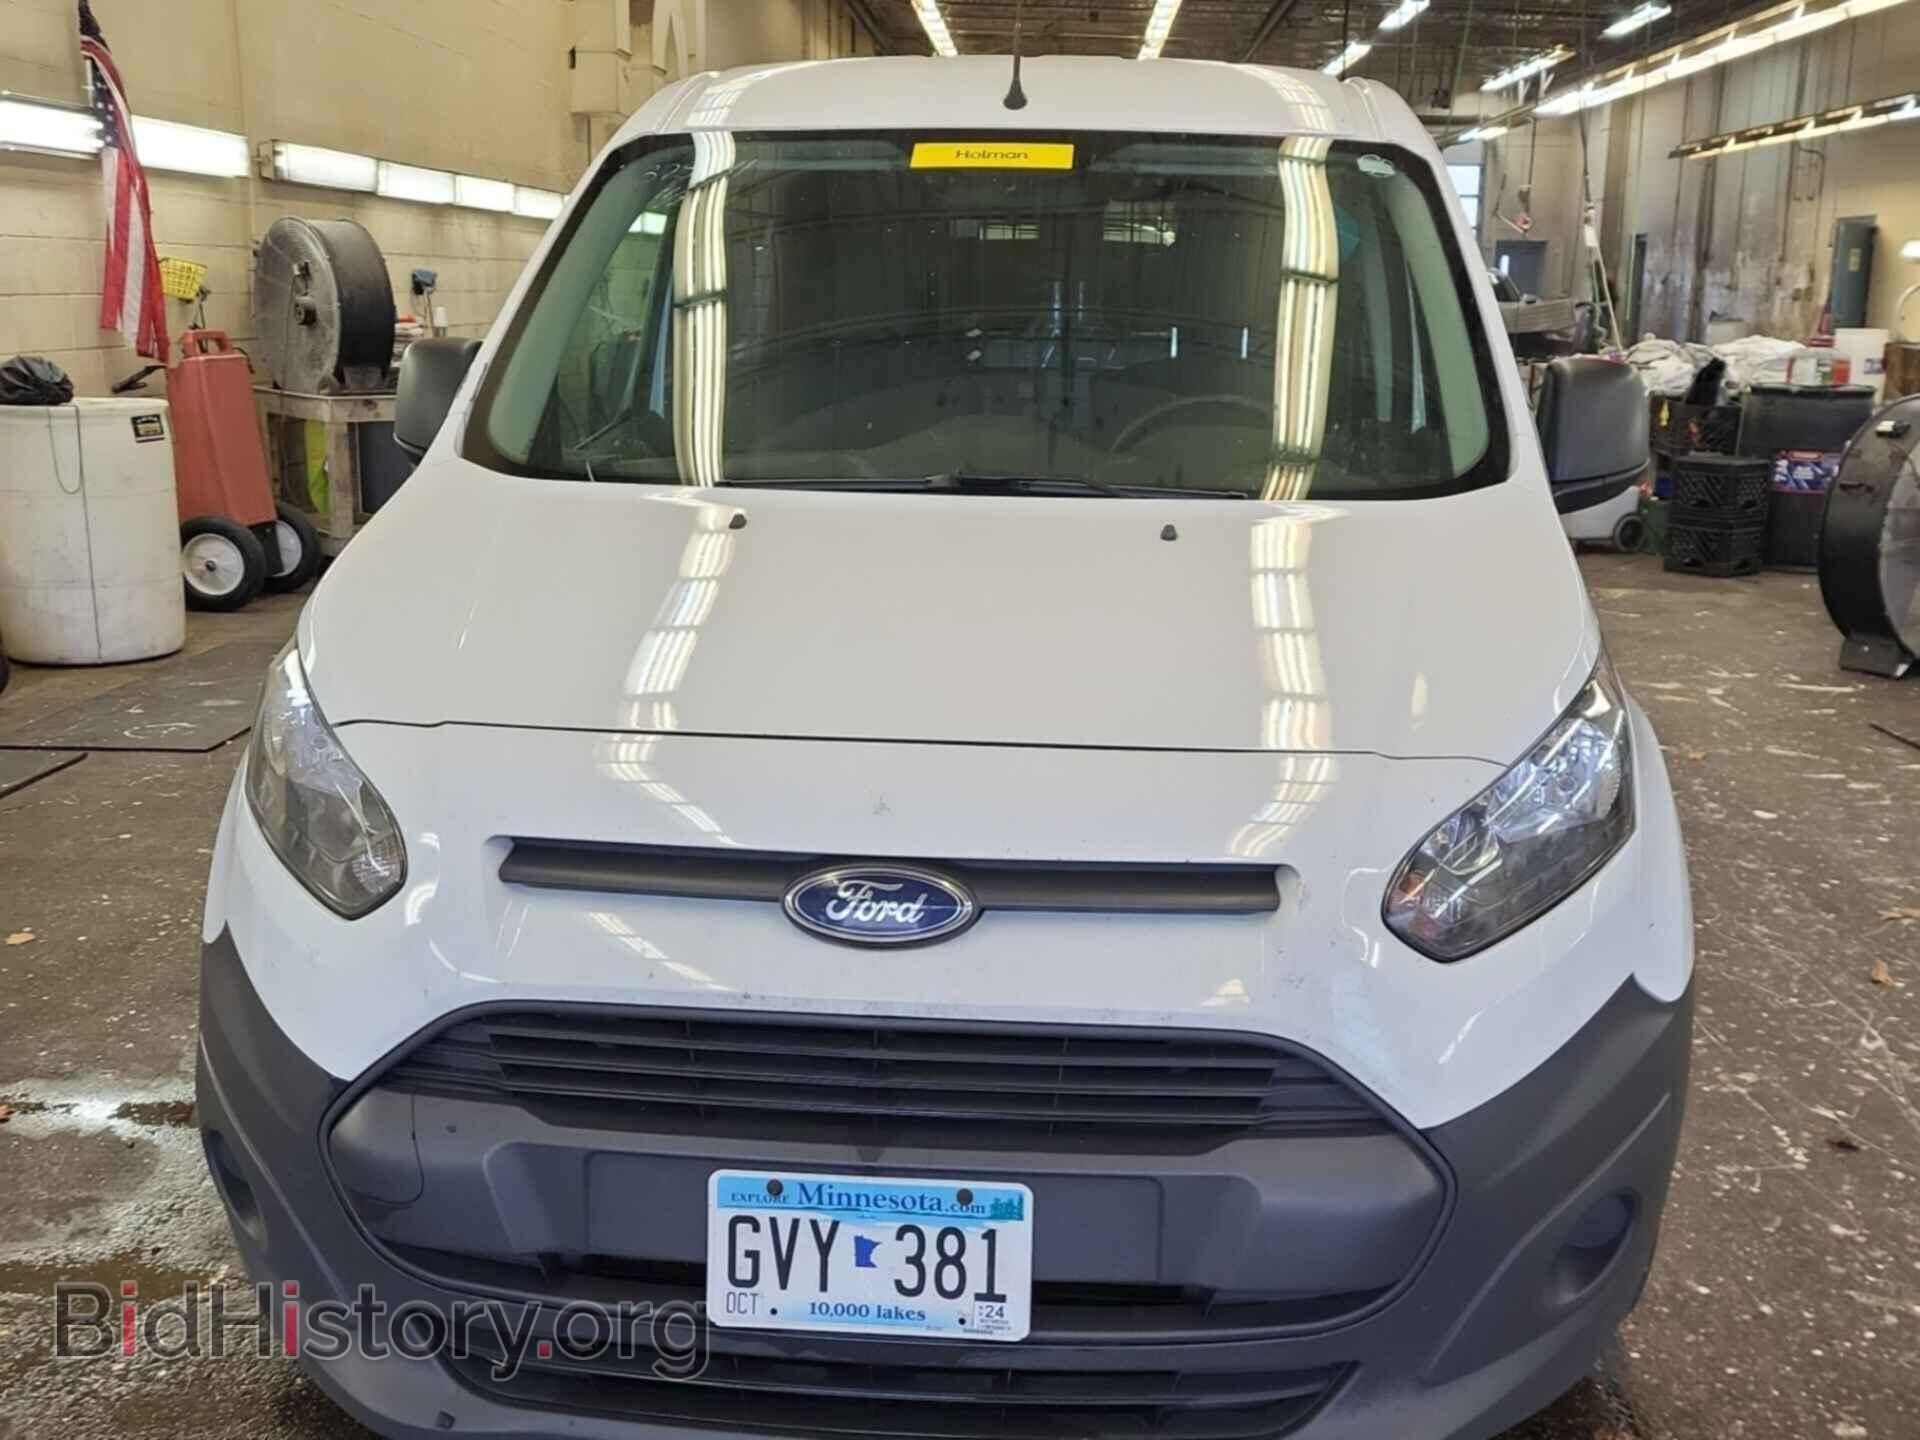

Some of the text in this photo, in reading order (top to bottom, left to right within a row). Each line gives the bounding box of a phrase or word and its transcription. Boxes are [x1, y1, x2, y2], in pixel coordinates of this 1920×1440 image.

[955, 149, 1029, 160] Holman
[826, 880, 928, 923] Ford
[728, 1215, 1006, 1303] GVY 381
[726, 1292, 759, 1315] OCT
[809, 1302, 926, 1321] 10,000 lakes
